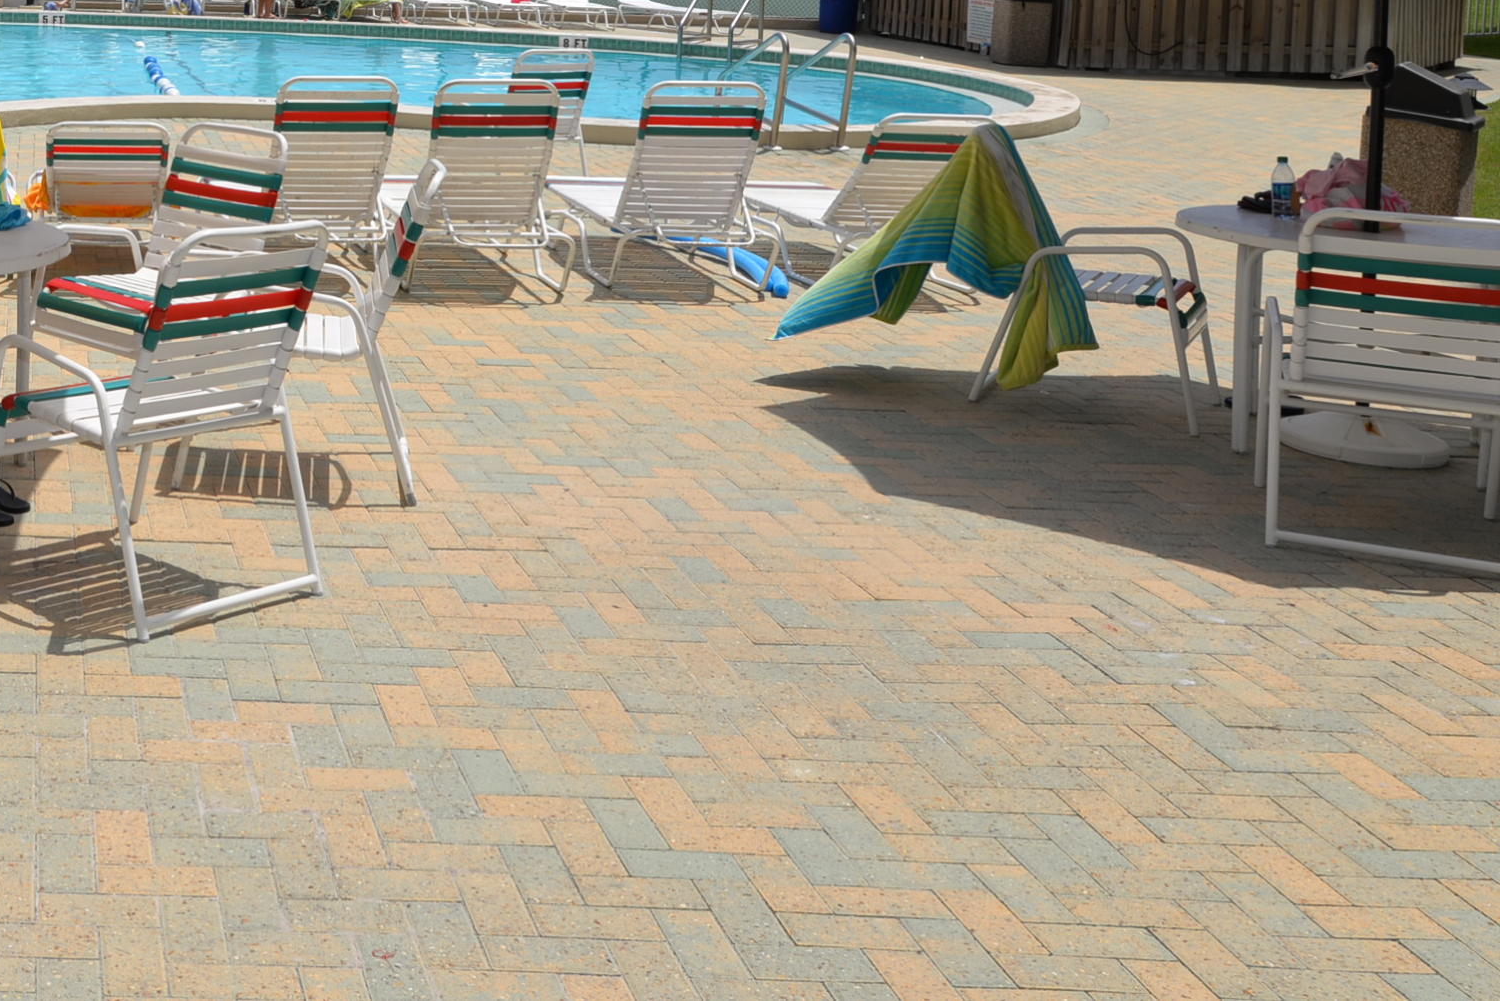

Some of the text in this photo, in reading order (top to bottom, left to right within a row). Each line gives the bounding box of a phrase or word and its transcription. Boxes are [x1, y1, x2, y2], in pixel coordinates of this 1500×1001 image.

[42, 15, 64, 24] 5 FT
[563, 38, 587, 48] 8 FT
